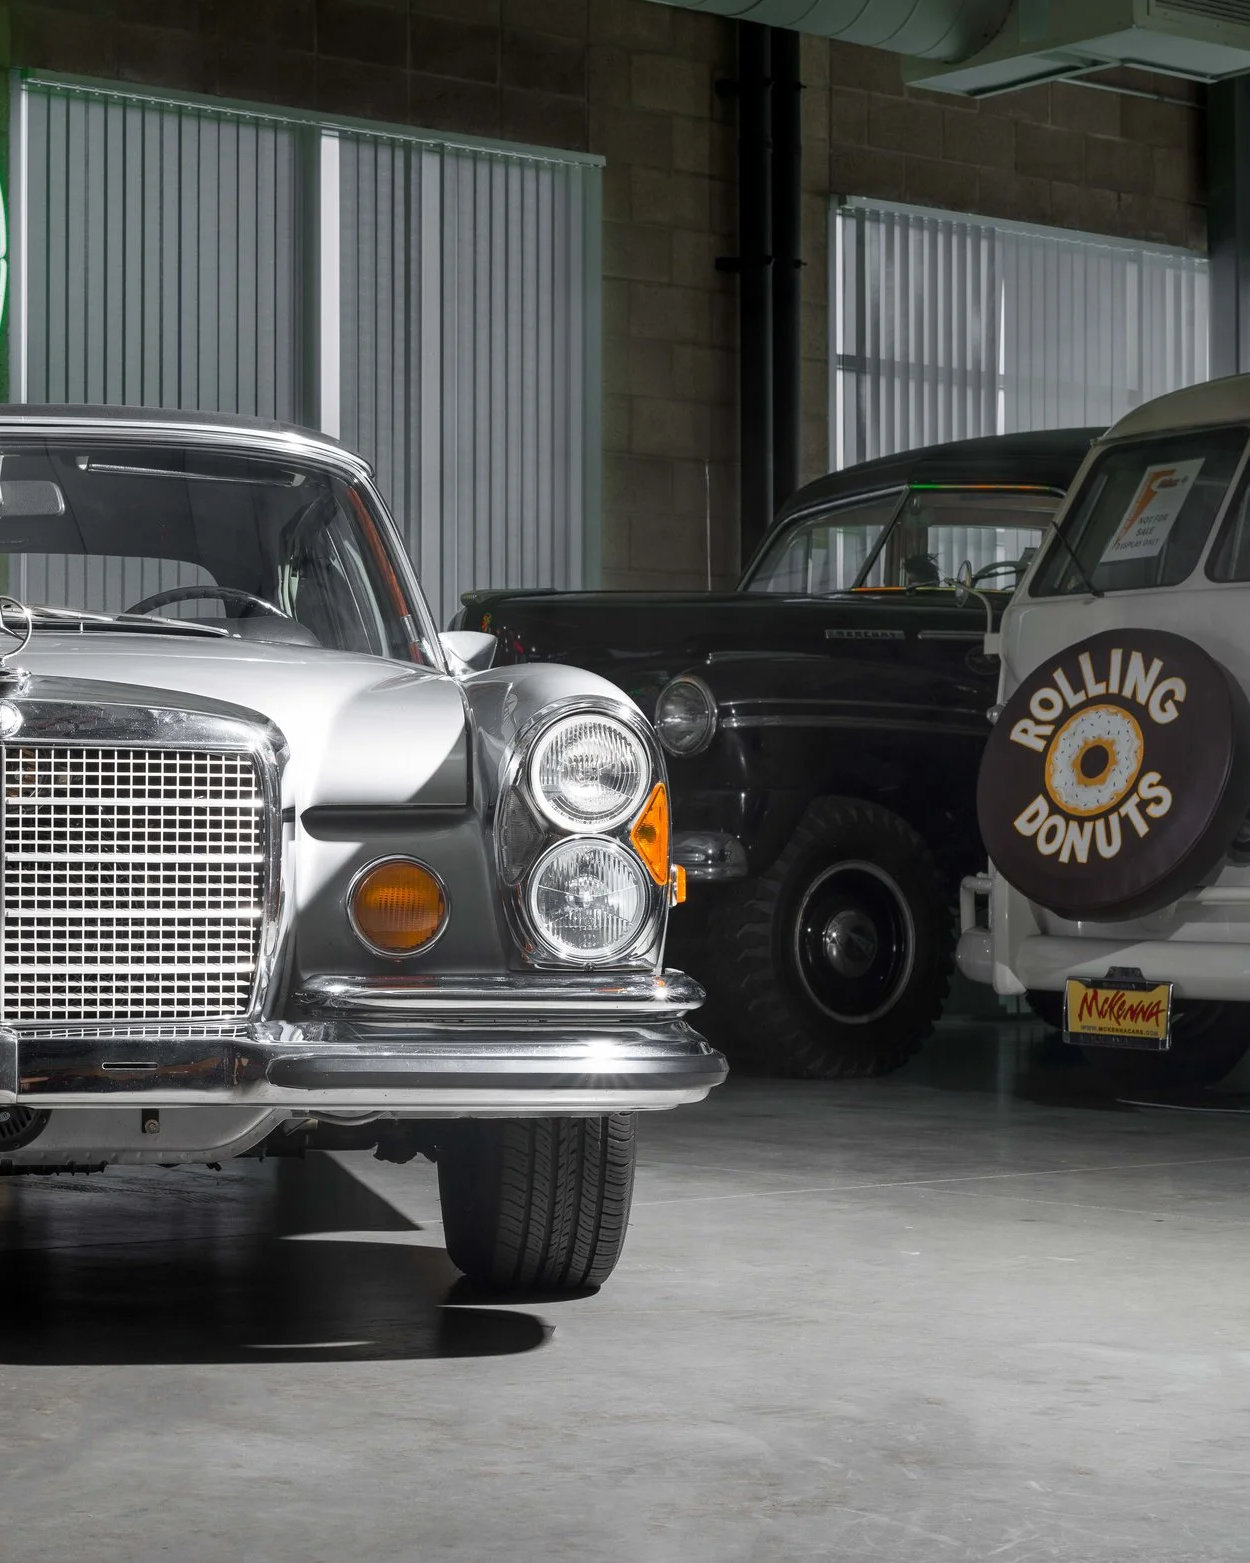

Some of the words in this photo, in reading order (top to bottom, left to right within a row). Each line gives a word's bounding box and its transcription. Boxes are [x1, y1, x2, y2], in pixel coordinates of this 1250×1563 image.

[1136, 526, 1155, 536] SALE
[1010, 648, 1187, 752] ROLLING
[1013, 770, 1172, 864] DONUTS
